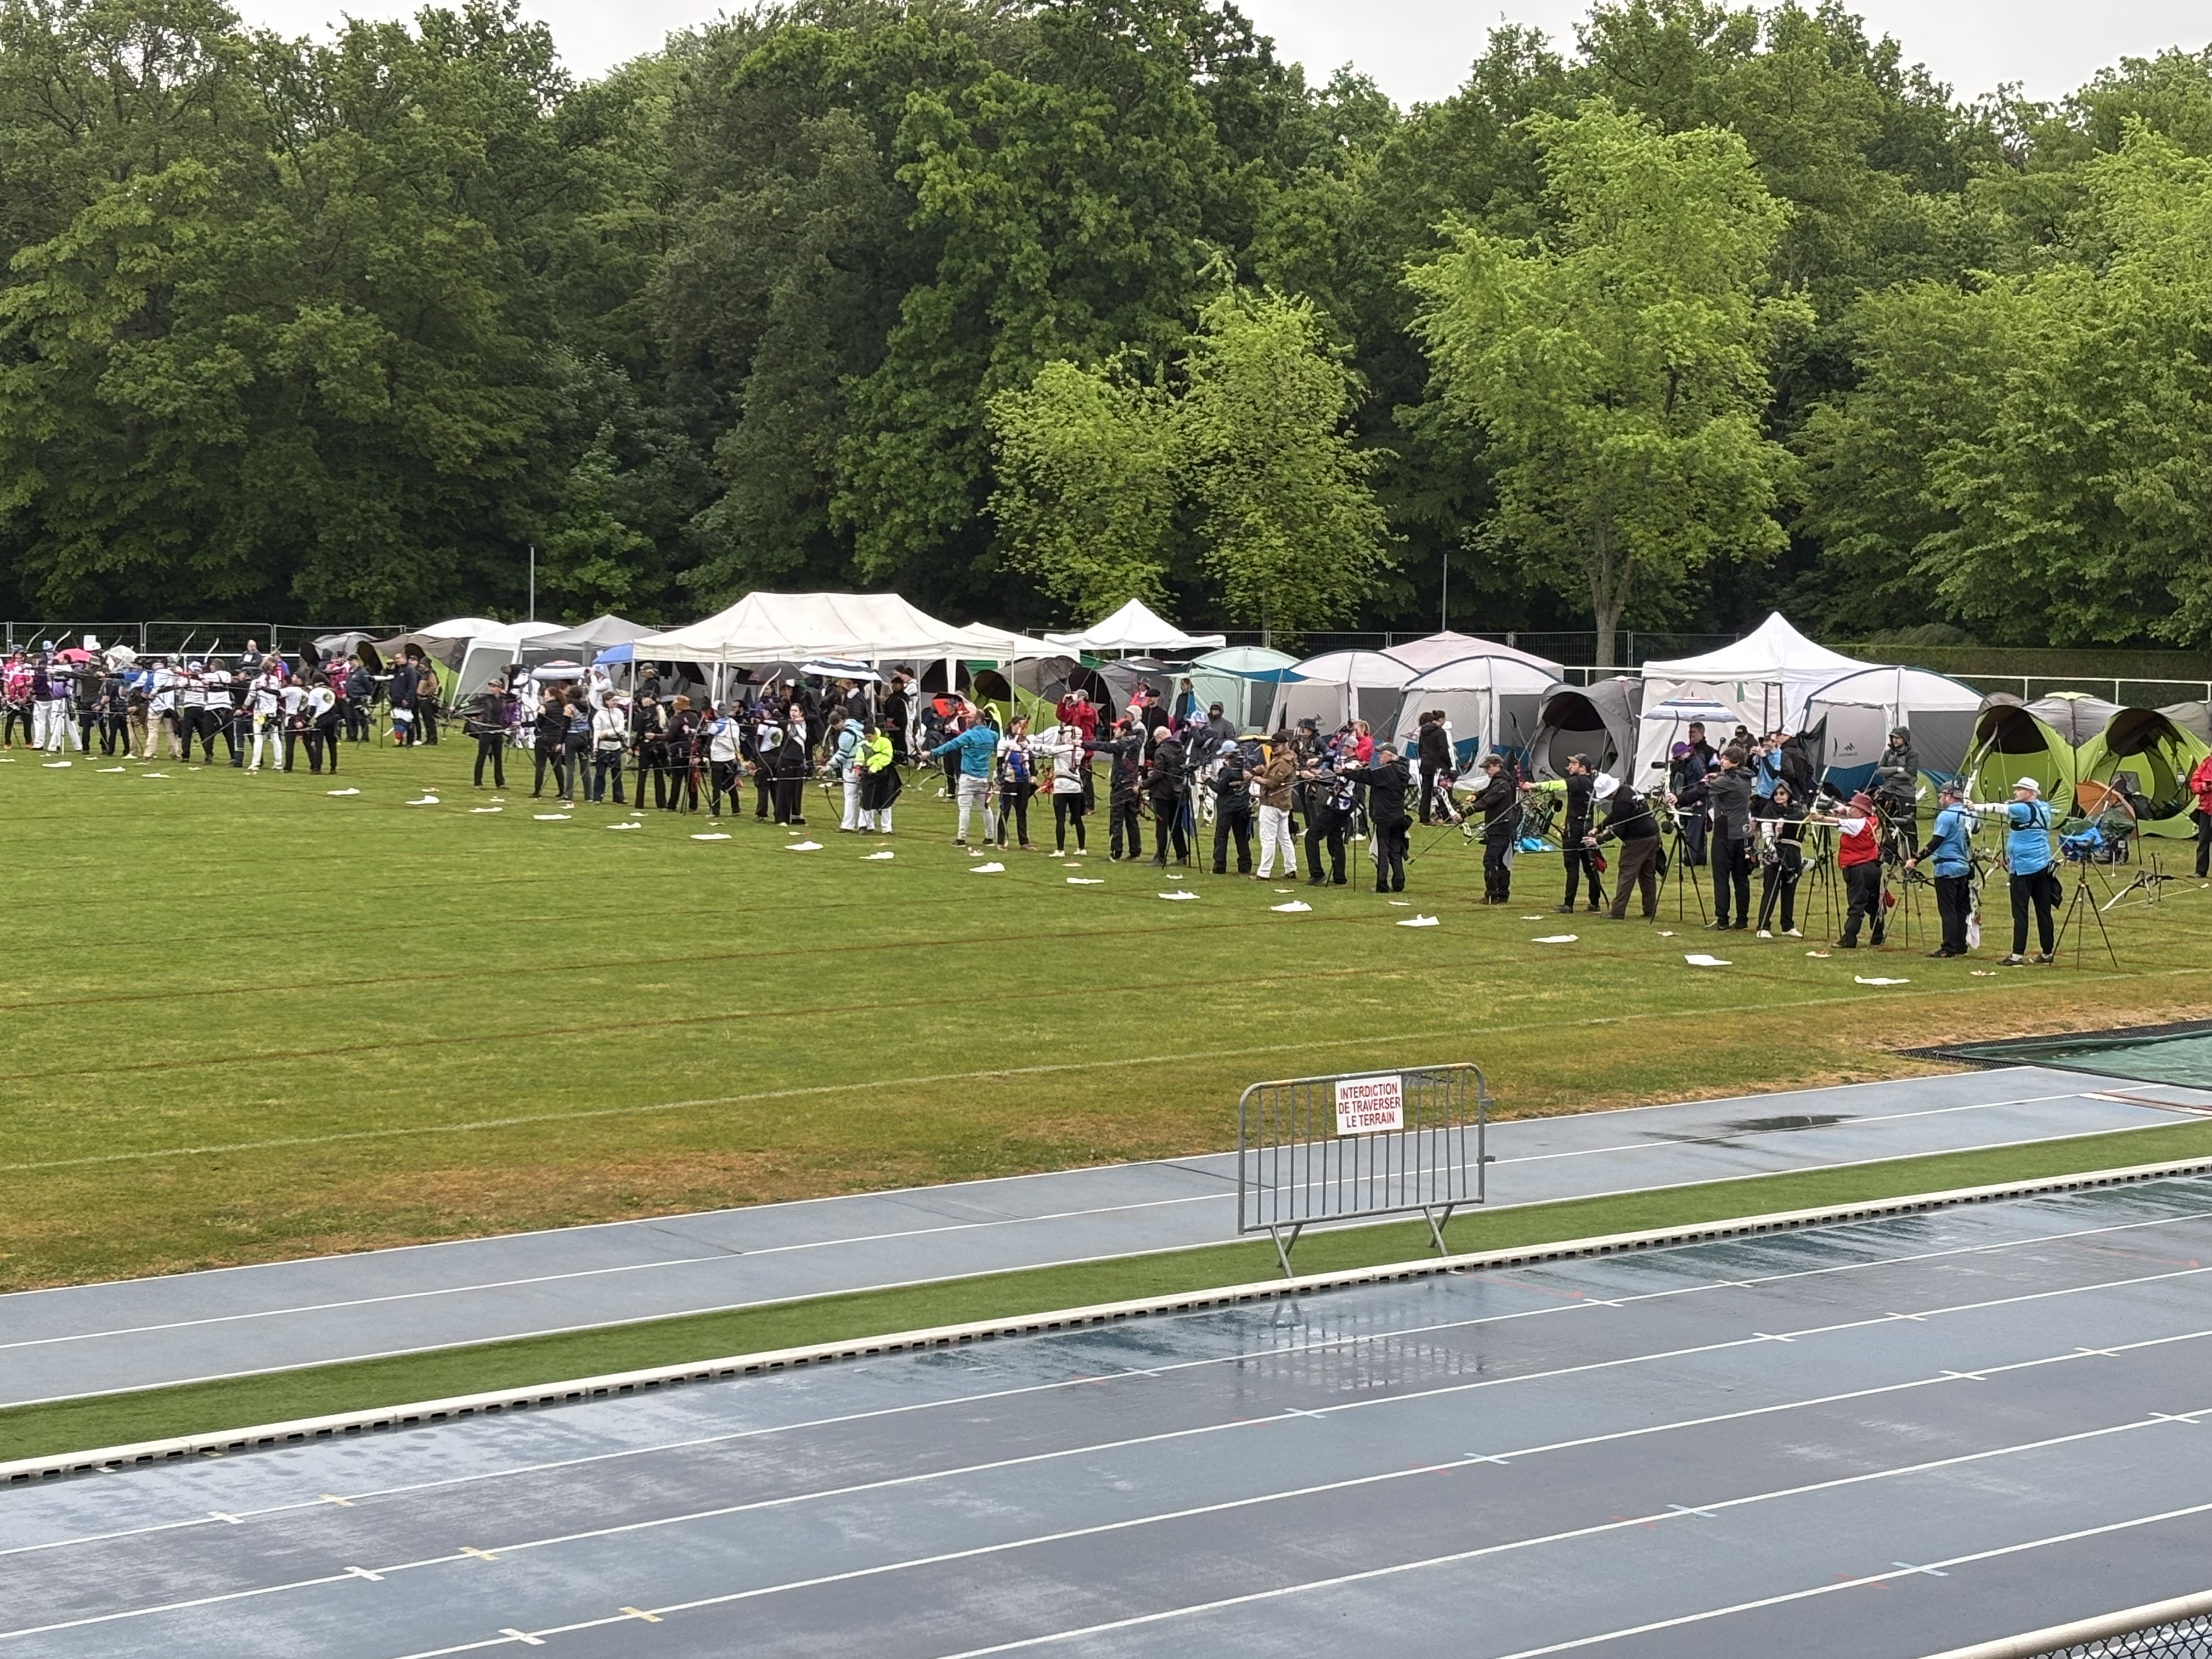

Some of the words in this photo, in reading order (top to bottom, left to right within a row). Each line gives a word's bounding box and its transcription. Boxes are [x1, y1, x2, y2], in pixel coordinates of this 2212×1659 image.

[1340, 1082, 1397, 1100] INTERDICTION
[1339, 1102, 1350, 1114] DE
[1352, 1097, 1401, 1113] TRAVERSER
[1346, 1115, 1357, 1128] LE
[1358, 1111, 1395, 1126] TERRAIN
